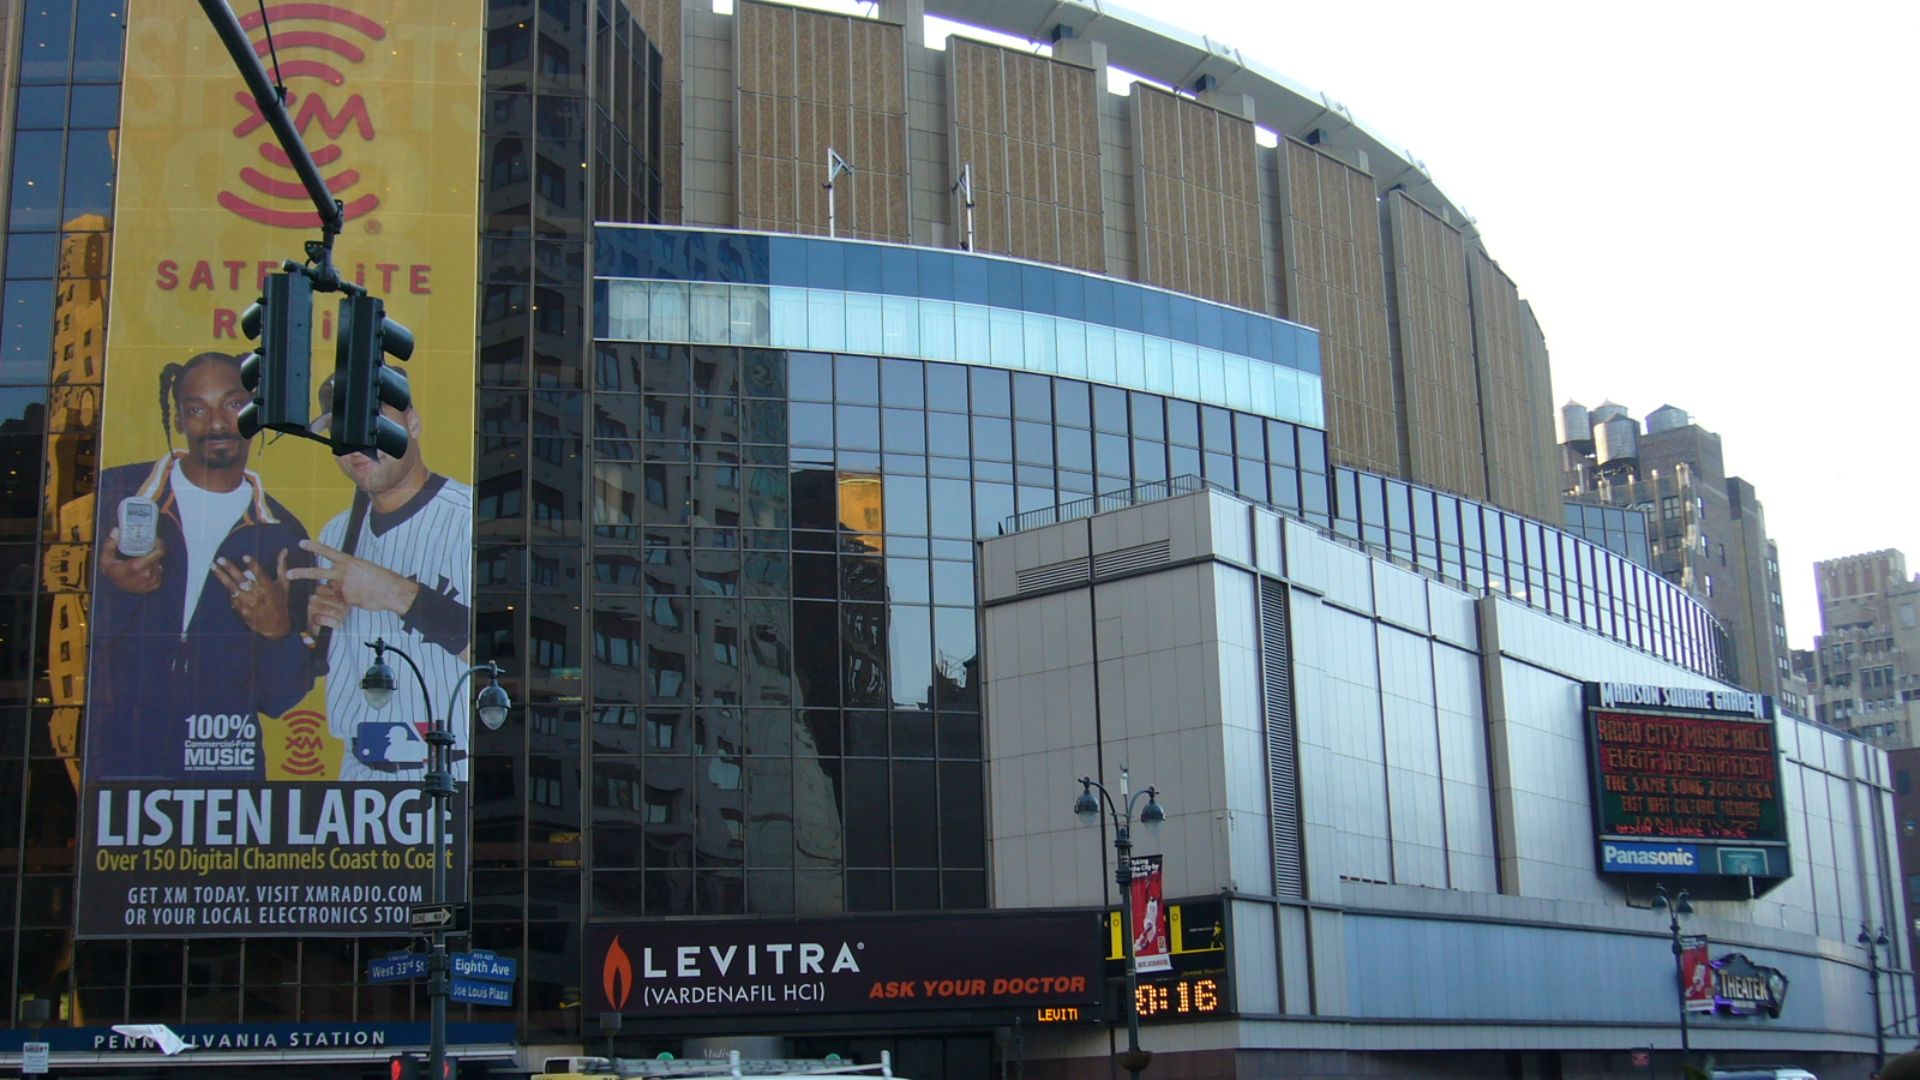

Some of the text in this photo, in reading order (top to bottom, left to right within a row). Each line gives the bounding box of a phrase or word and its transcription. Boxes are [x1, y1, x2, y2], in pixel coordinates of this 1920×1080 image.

[156, 260, 432, 294] SATiTE
[1601, 681, 1763, 718] MADISON SQUARE GARDEN
[185, 714, 256, 739] 100%
[1599, 719, 1768, 751] RADIO CITY MUSIC HALL
[285, 736, 323, 750] XM
[184, 748, 255, 766] MUSIC
[1609, 747, 1657, 769] EVENT
[1604, 774, 1629, 792] THE
[1633, 775, 1666, 794] SAME
[1671, 777, 1705, 796] SONG
[97, 789, 272, 846] LISTEN
[96, 847, 453, 876] Over 150 Digital Channels Coast to Coat
[1603, 845, 1694, 866] Panasonic
[128, 885, 422, 904] GET XM TODAY. VISIT XMRADIO.COM
[125, 906, 409, 925] OR YOUR LOCAL ELECTRONICS STO
[372, 960, 425, 978] West 33rd St
[455, 959, 510, 976] Eighth Ave
[454, 985, 508, 1000] Joe Louis Plaza
[644, 984, 776, 1007] (VARDENAFIL
[868, 976, 1086, 998] ASK YOUR DOCTOR
[1720, 970, 1769, 1000] THEATER
[95, 1031, 385, 1048] PENNLVANIA STATION
